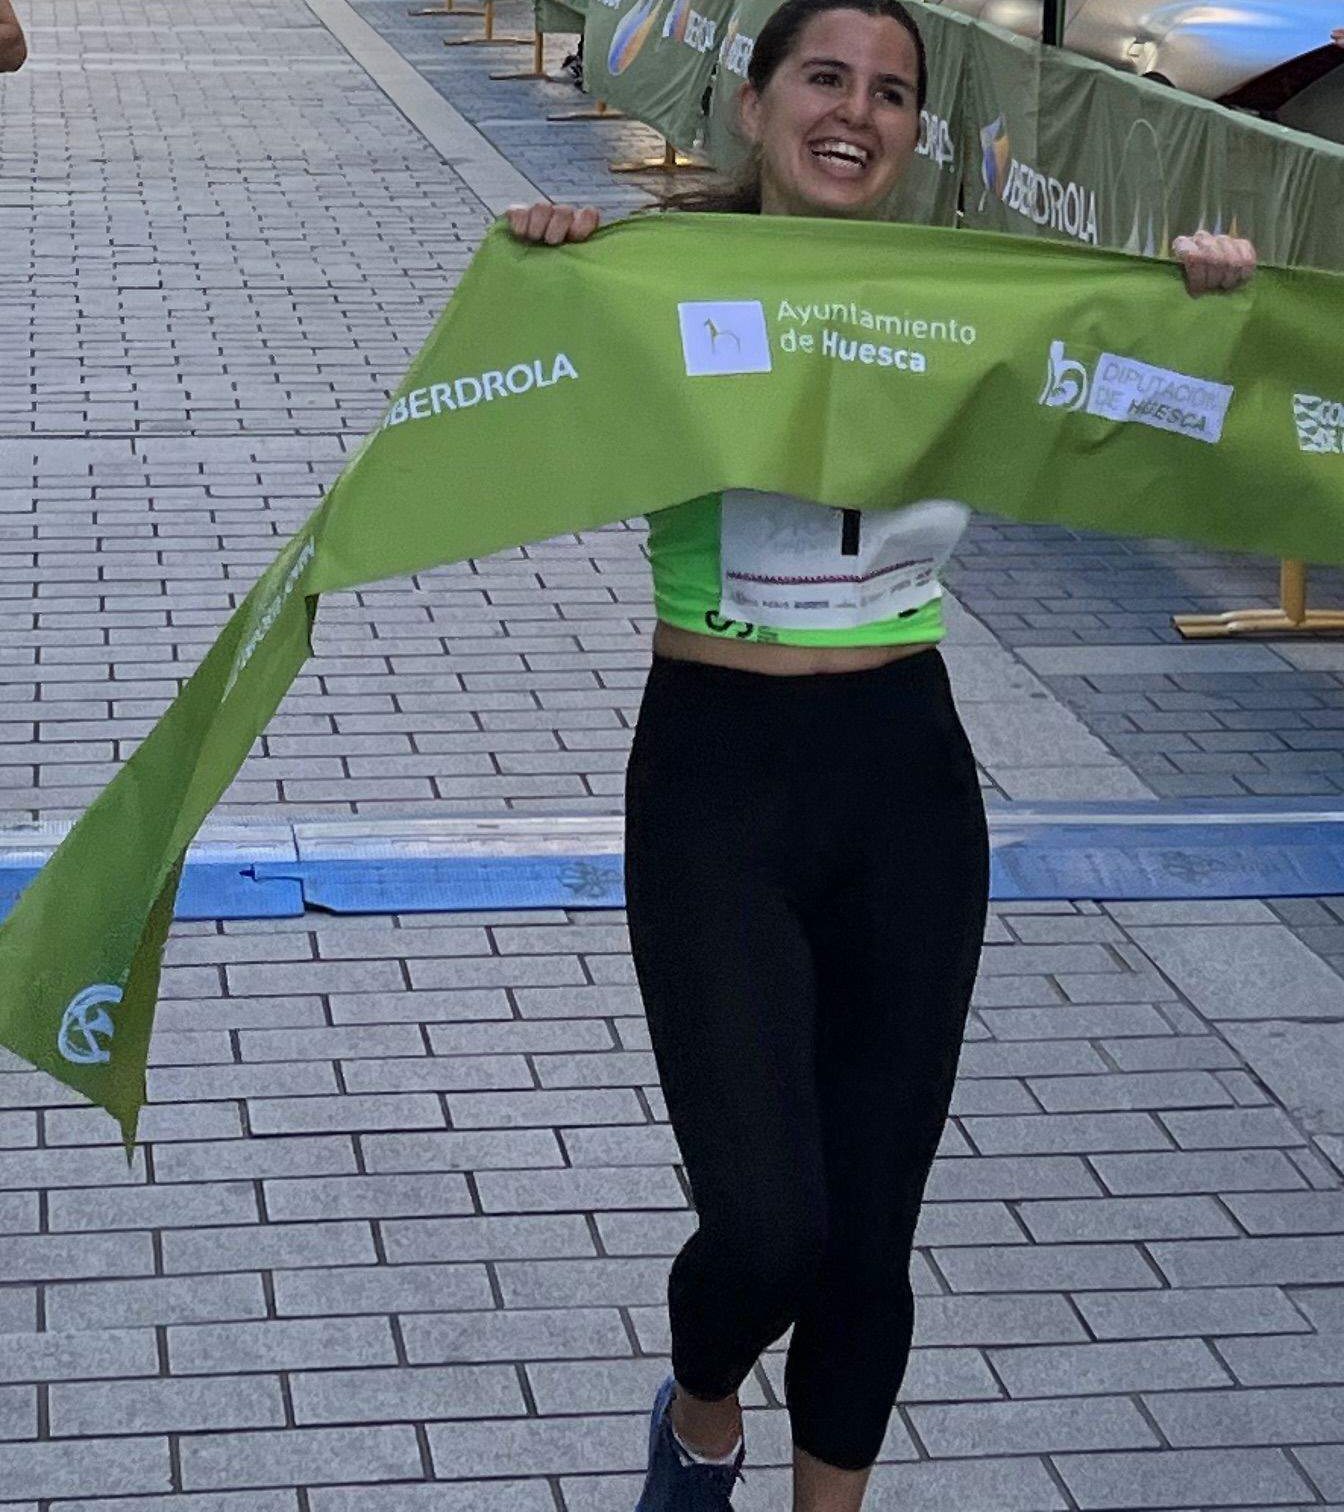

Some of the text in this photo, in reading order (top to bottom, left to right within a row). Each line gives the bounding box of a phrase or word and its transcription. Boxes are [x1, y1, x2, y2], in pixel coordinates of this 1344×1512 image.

[777, 299, 977, 346] Ayuntamiento
[779, 327, 927, 373] de Huesca
